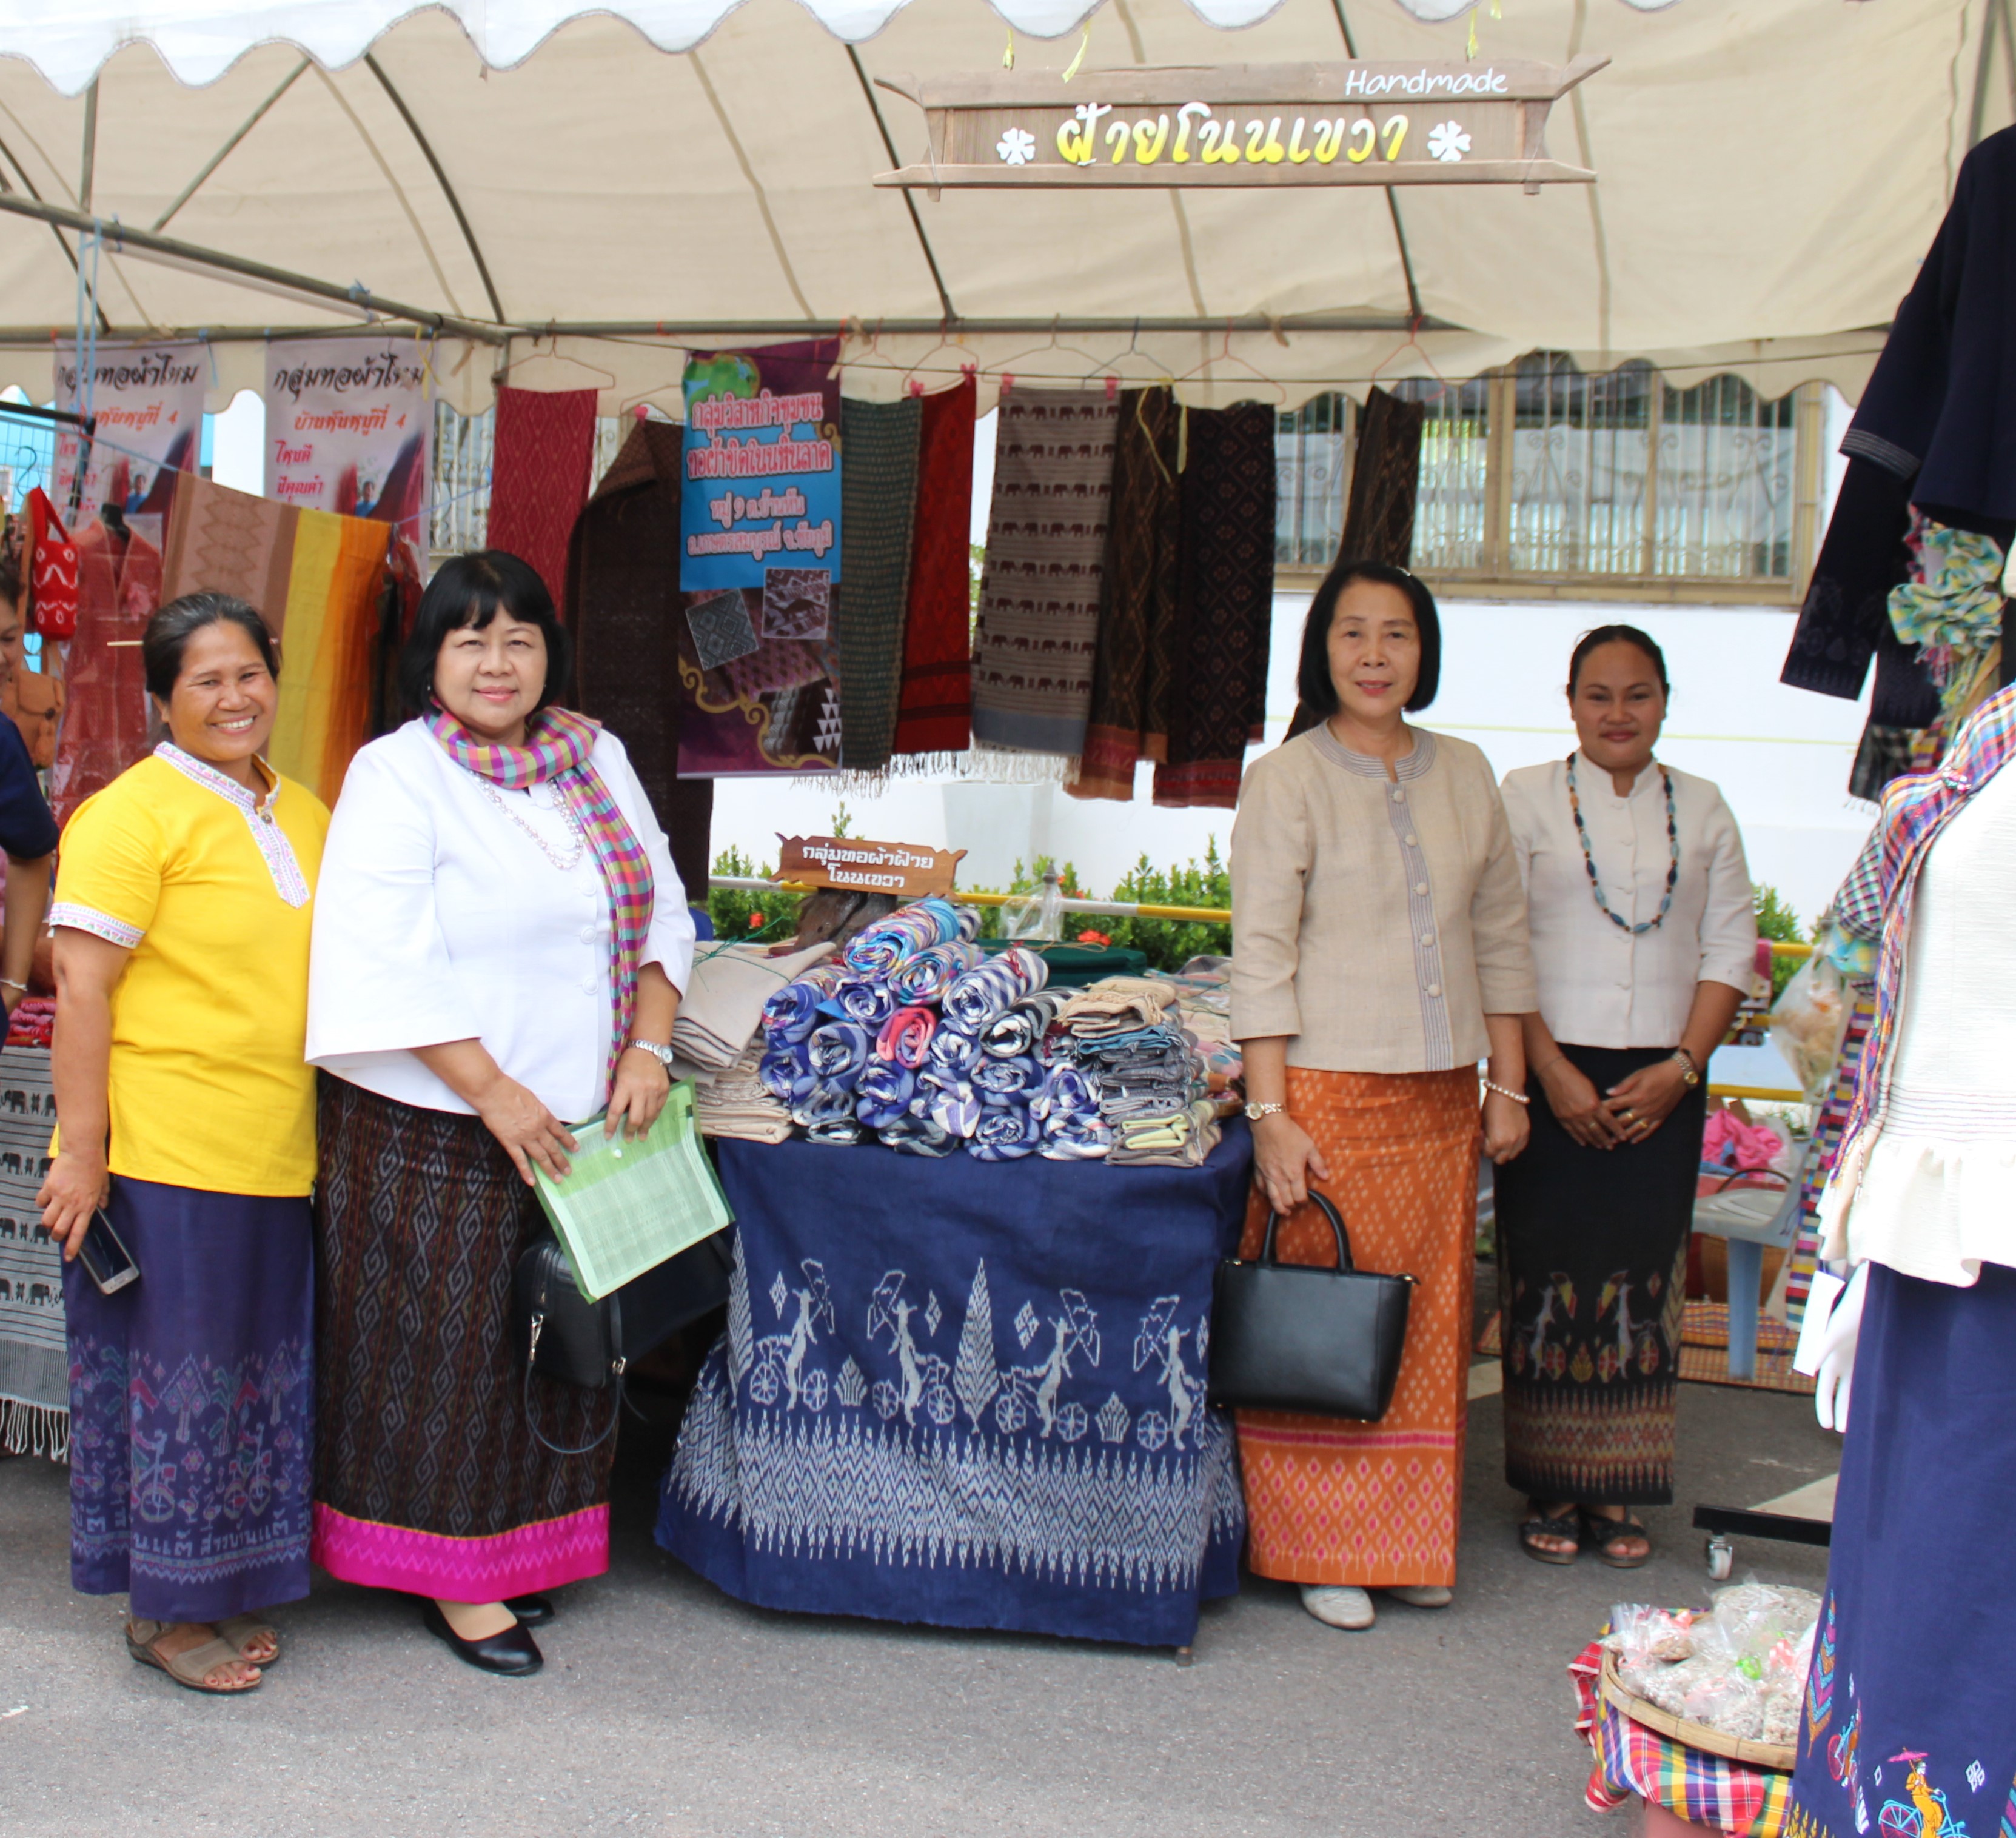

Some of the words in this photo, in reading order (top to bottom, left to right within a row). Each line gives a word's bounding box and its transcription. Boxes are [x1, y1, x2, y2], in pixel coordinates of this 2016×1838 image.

[1344, 68, 1509, 96] Handmade
[1056, 101, 1410, 167] ฝ้ายโนนเขวา
[395, 413, 407, 428] 4
[802, 843, 934, 869] กลุ่มทอผ้าฝ้าย
[827, 863, 905, 887] โนนเขวา
